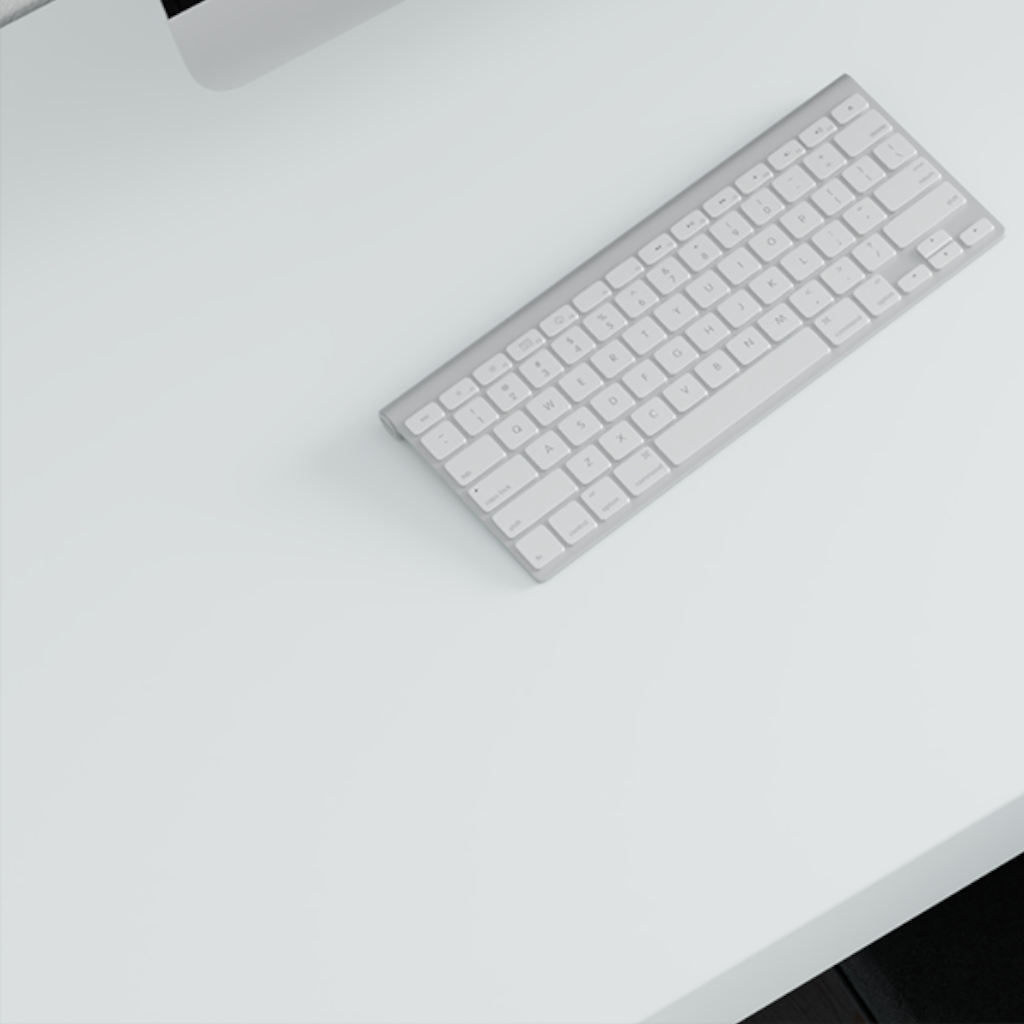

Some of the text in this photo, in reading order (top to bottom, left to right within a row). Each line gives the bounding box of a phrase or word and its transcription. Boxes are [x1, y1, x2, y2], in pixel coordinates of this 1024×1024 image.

[512, 425, 523, 434] Q
[542, 399, 555, 411] W
[577, 377, 586, 386] E
[609, 354, 618, 362] R
[641, 330, 649, 338] T
[672, 307, 681, 315] Y
[703, 283, 714, 293] U
[766, 237, 777, 246] O
[798, 214, 806, 223] P
[544, 445, 554, 454] A
[576, 420, 586, 429] S
[608, 396, 618, 406] D
[640, 372, 648, 381] F
[672, 348, 683, 358] G
[704, 325, 714, 335] H
[767, 278, 777, 288] K
[798, 257, 808, 265] L
[583, 314, 787, 467] Z X C V B N M
